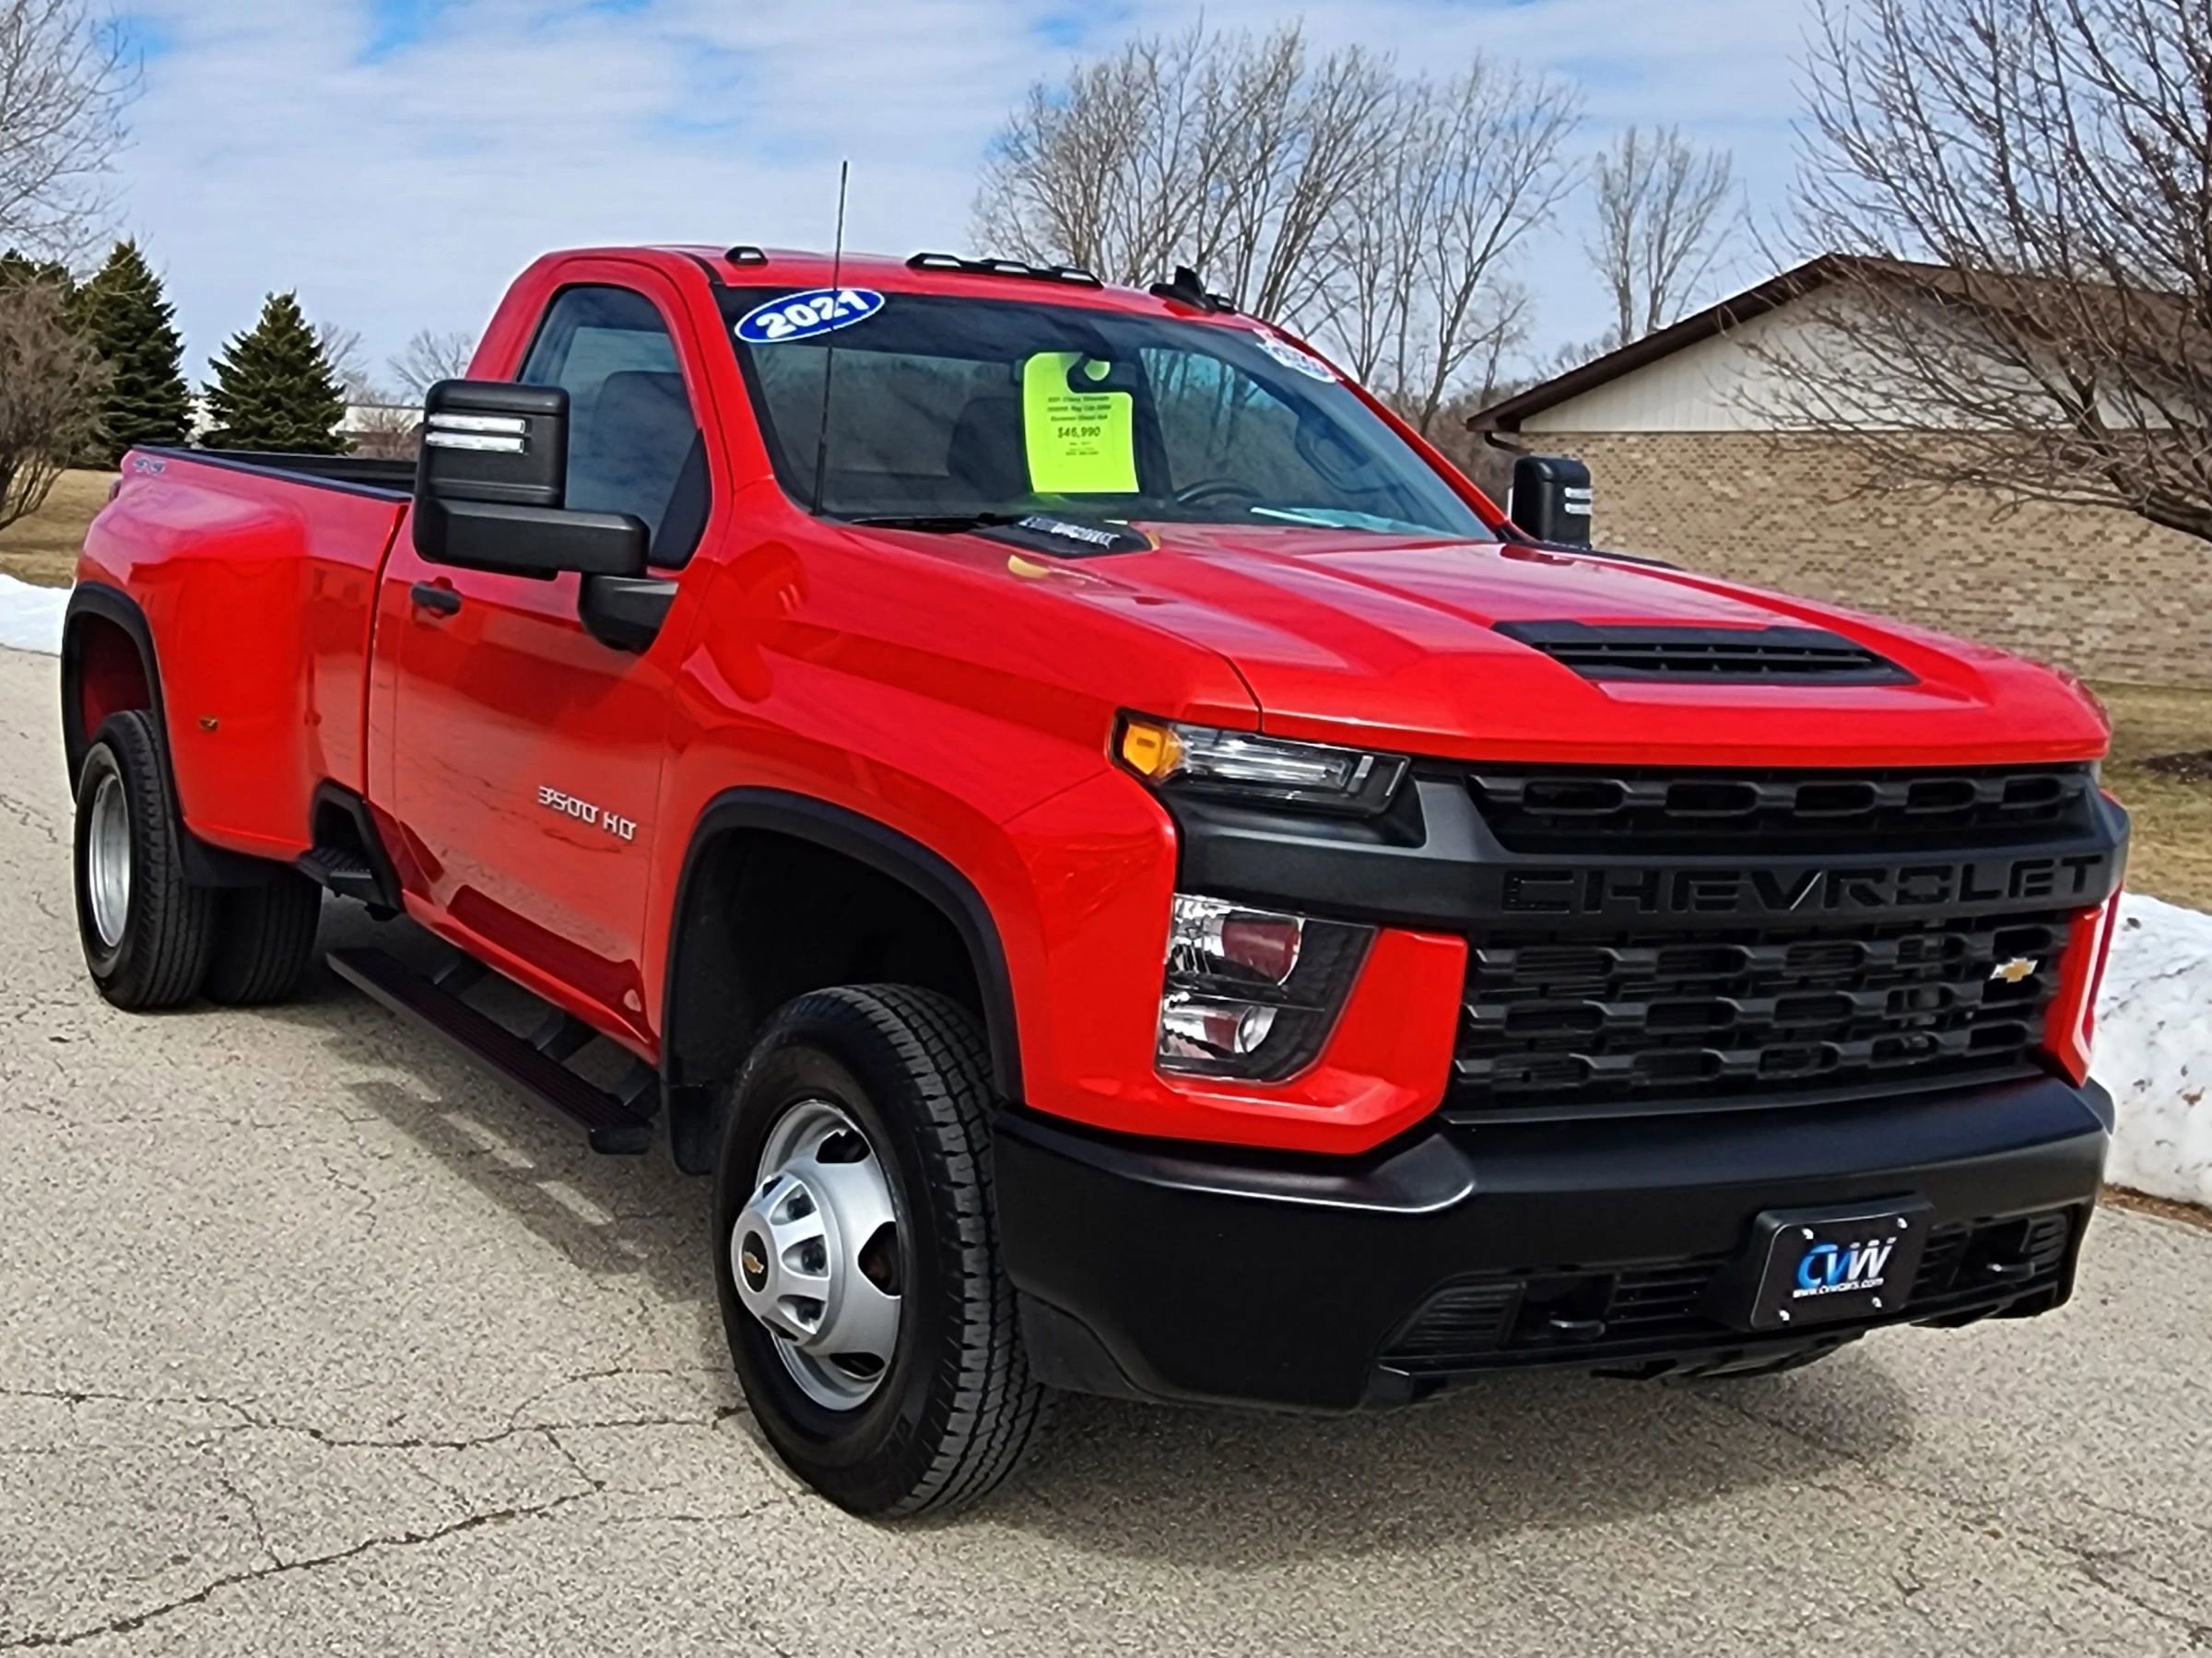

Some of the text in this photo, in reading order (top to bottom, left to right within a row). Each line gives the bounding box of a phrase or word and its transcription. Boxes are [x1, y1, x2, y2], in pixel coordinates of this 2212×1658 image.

[756, 290, 869, 338] 2021
[538, 785, 637, 841] 3500 HD
[1502, 854, 2101, 914] CHEVROLET
[1798, 1238, 1897, 1286] CVW
